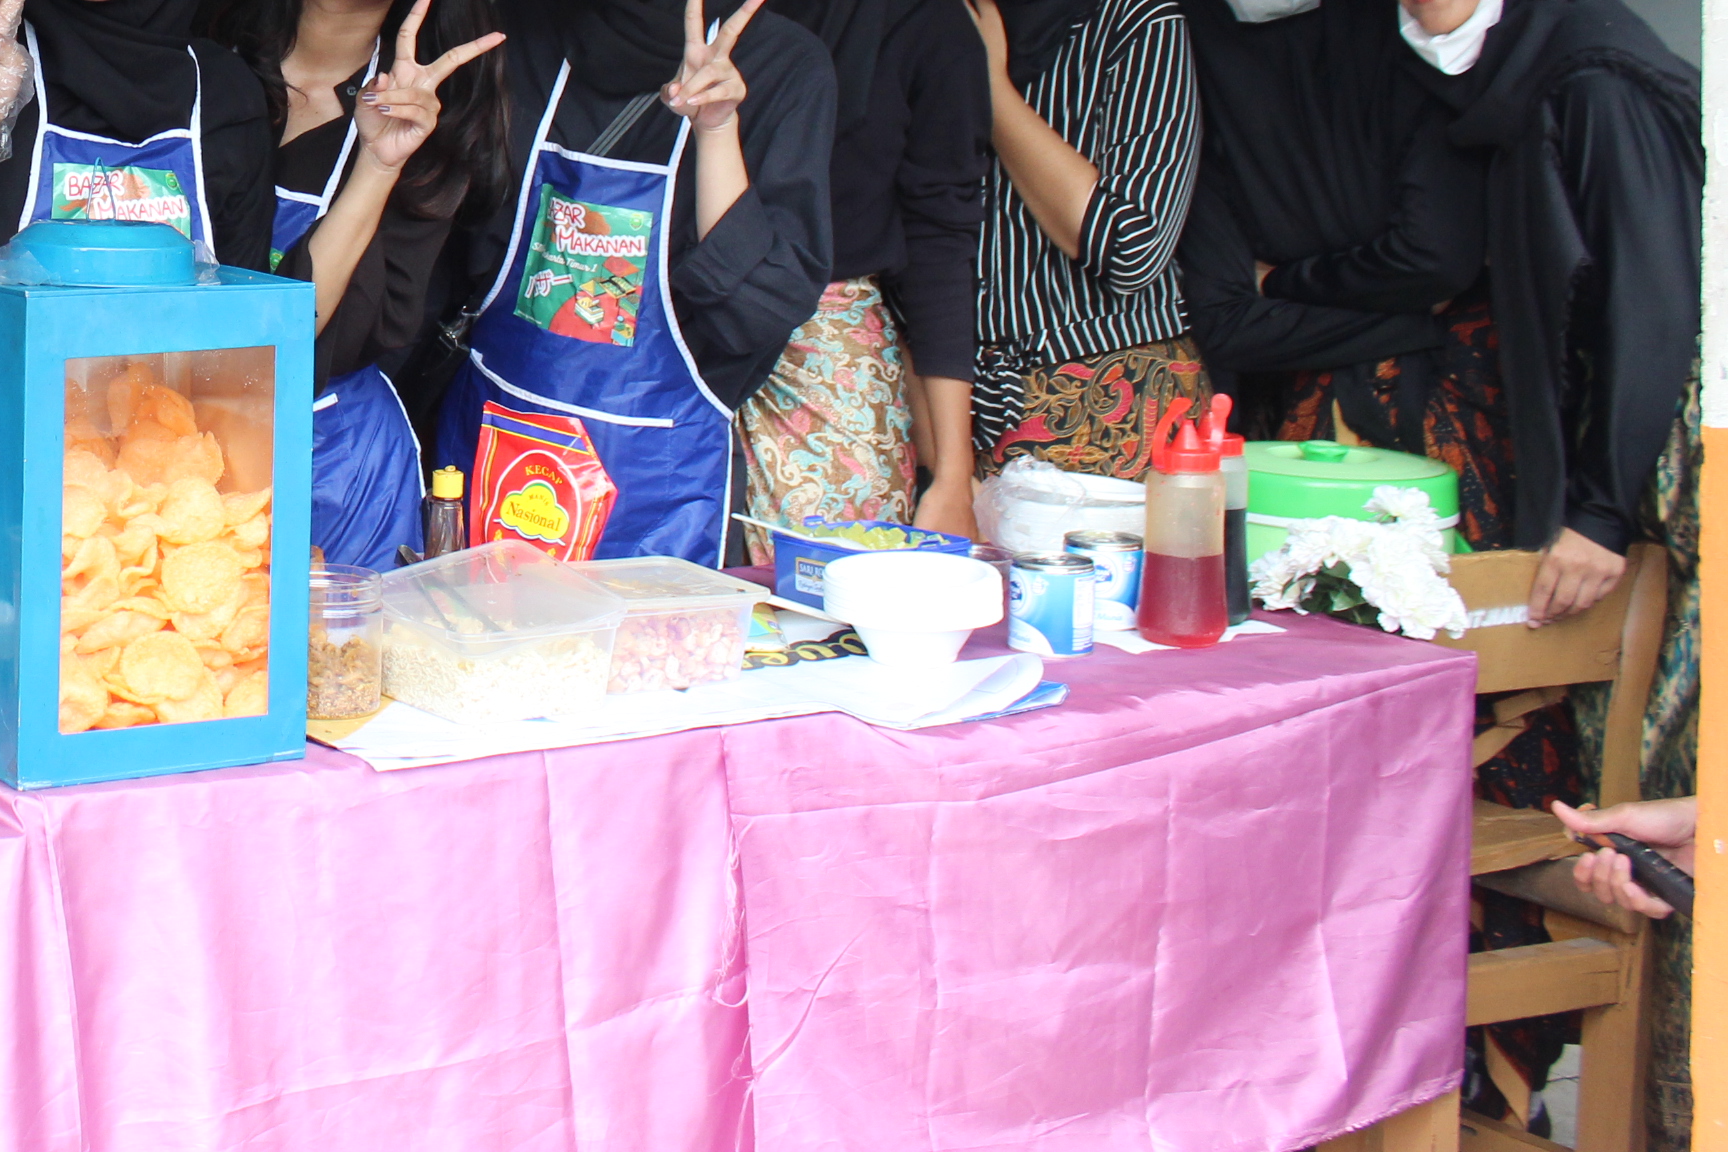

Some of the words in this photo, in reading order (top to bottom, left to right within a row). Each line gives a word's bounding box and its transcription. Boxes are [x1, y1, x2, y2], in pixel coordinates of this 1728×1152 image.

[97, 196, 184, 220] MAKANAN
[557, 228, 644, 255] MAKANAN
[525, 464, 563, 485] KECAP
[506, 501, 562, 532] Nasional
